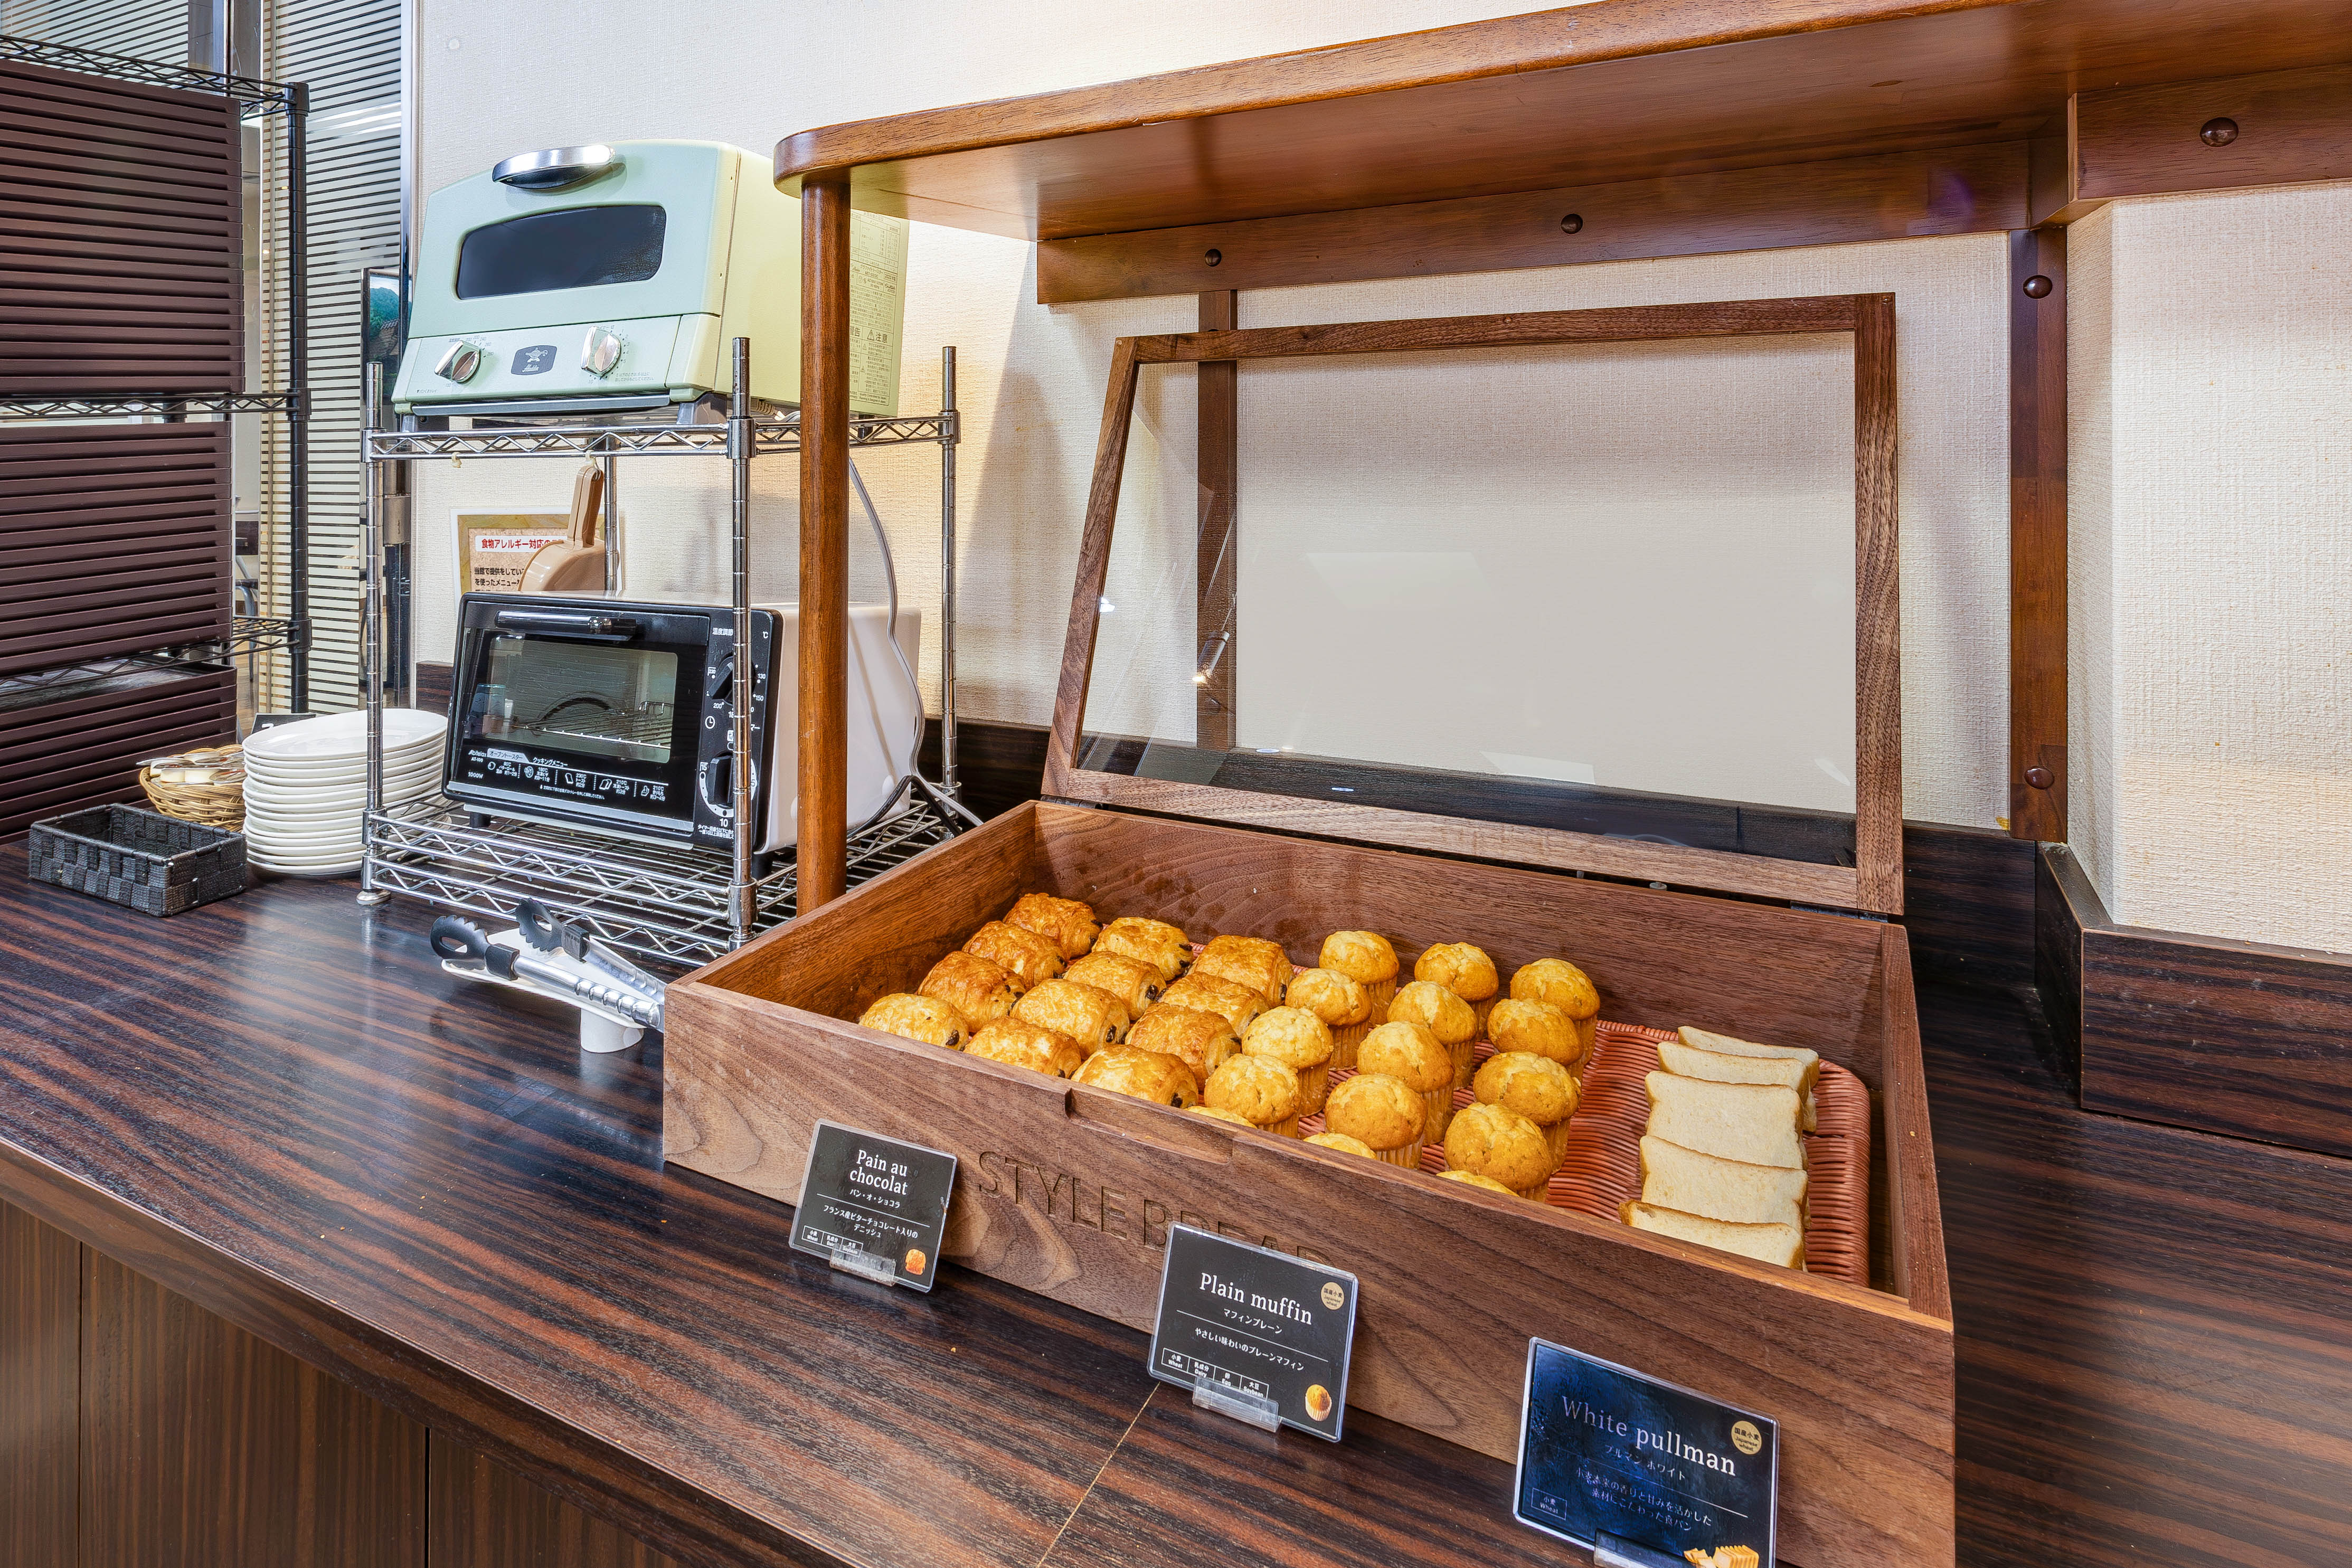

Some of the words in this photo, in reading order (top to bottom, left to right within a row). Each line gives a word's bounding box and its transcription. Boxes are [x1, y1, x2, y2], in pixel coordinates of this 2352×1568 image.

[875, 332, 888, 343] 注意
[533, 757, 568, 768] クッキングメニュー
[719, 818, 729, 827] 10
[856, 1149, 887, 1172] Pain
[891, 1163, 908, 1177] au
[849, 1166, 908, 1195] chocolat
[849, 1189, 900, 1208] パン・オ・ショコラ
[978, 1151, 1129, 1240] STYLE
[823, 1205, 918, 1239] フランス産ビターチョコレート入りの
[854, 1223, 882, 1238] デニッシュ
[1199, 1272, 1245, 1303] Plain
[1251, 1292, 1312, 1325] muffin
[1223, 1308, 1283, 1335] マフィンプレーン
[1195, 1327, 1305, 1372] やさしい味わいのプレーンマフィン
[1168, 1359, 1183, 1369] Wheat
[1194, 1368, 1207, 1378] Dairy
[1243, 1385, 1264, 1398] Soybean
[1249, 1381, 1260, 1390] 大豆
[1562, 1395, 1627, 1437] White
[1636, 1428, 1736, 1477] pullman
[1647, 1460, 1686, 1481] ホワイト
[1539, 1501, 1558, 1514] Wheat
